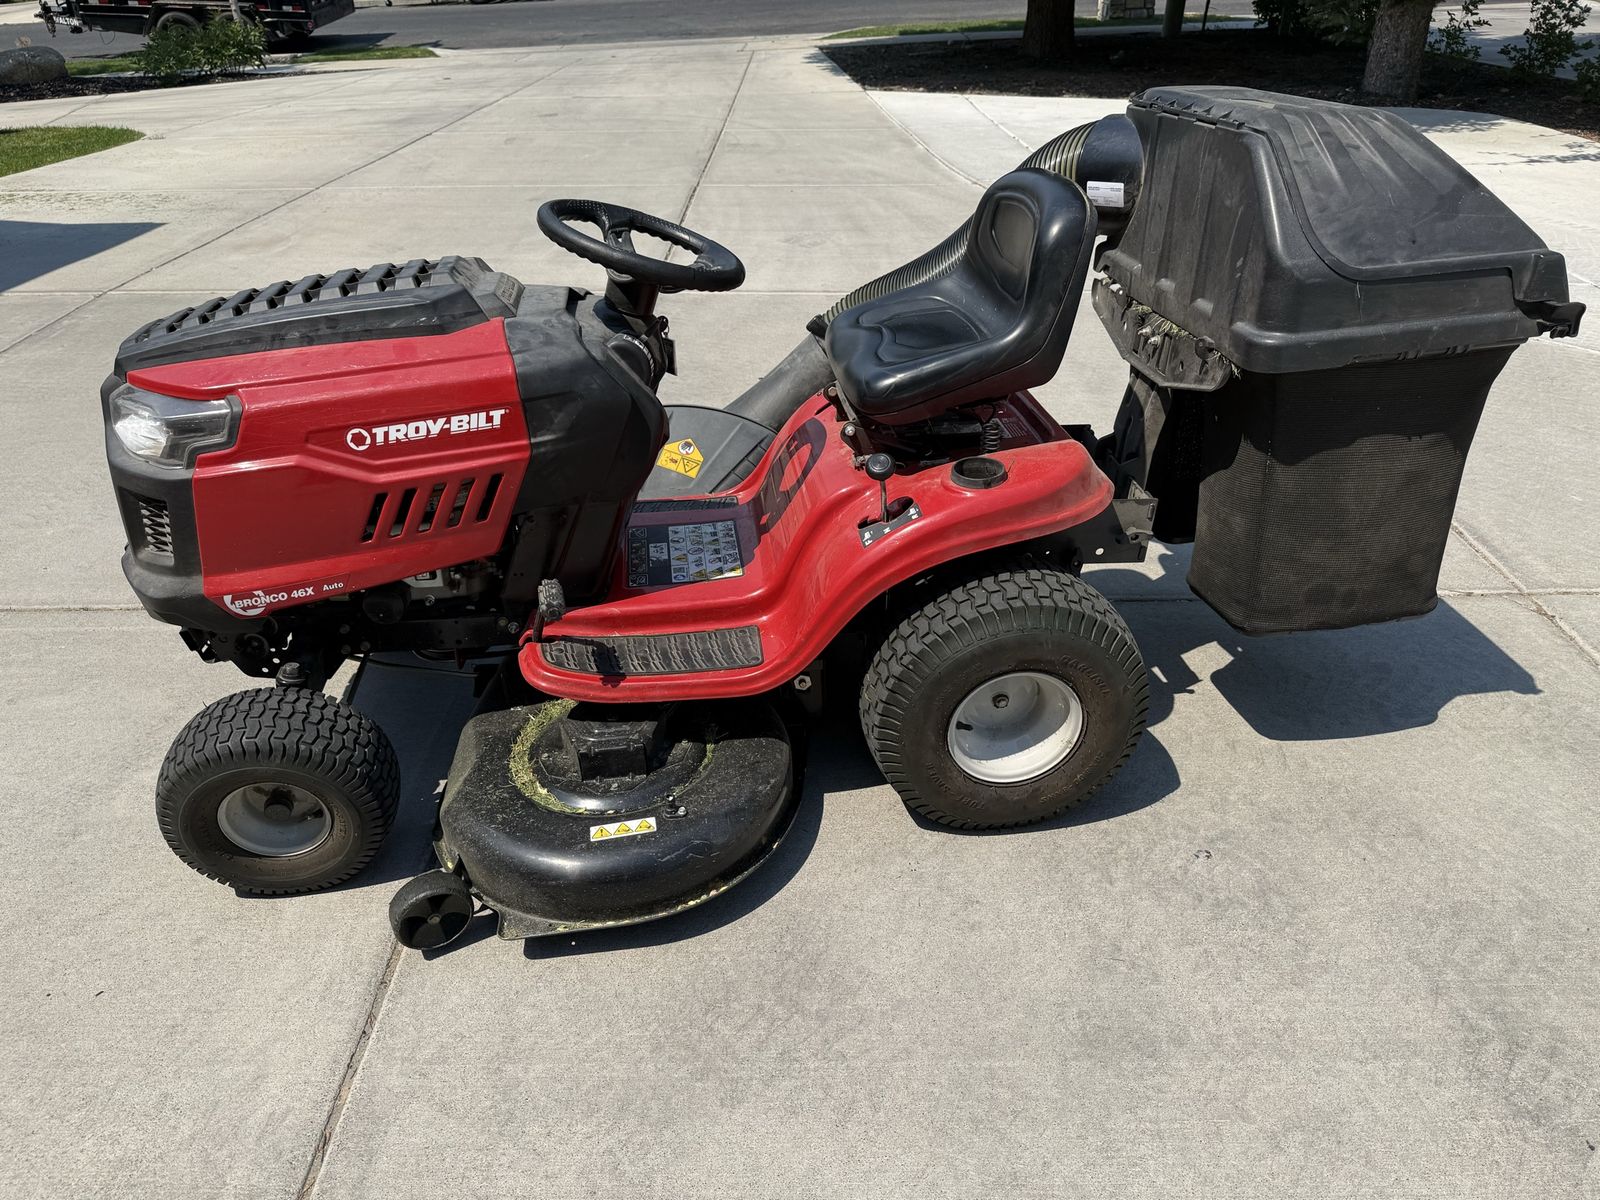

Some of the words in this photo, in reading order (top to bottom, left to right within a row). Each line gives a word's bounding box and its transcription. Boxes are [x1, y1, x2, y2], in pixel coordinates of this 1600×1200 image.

[372, 409, 505, 446] TROY-BILT
[234, 592, 288, 609] BRONCO
[291, 586, 315, 598] 46X
[322, 582, 344, 591] Auto
